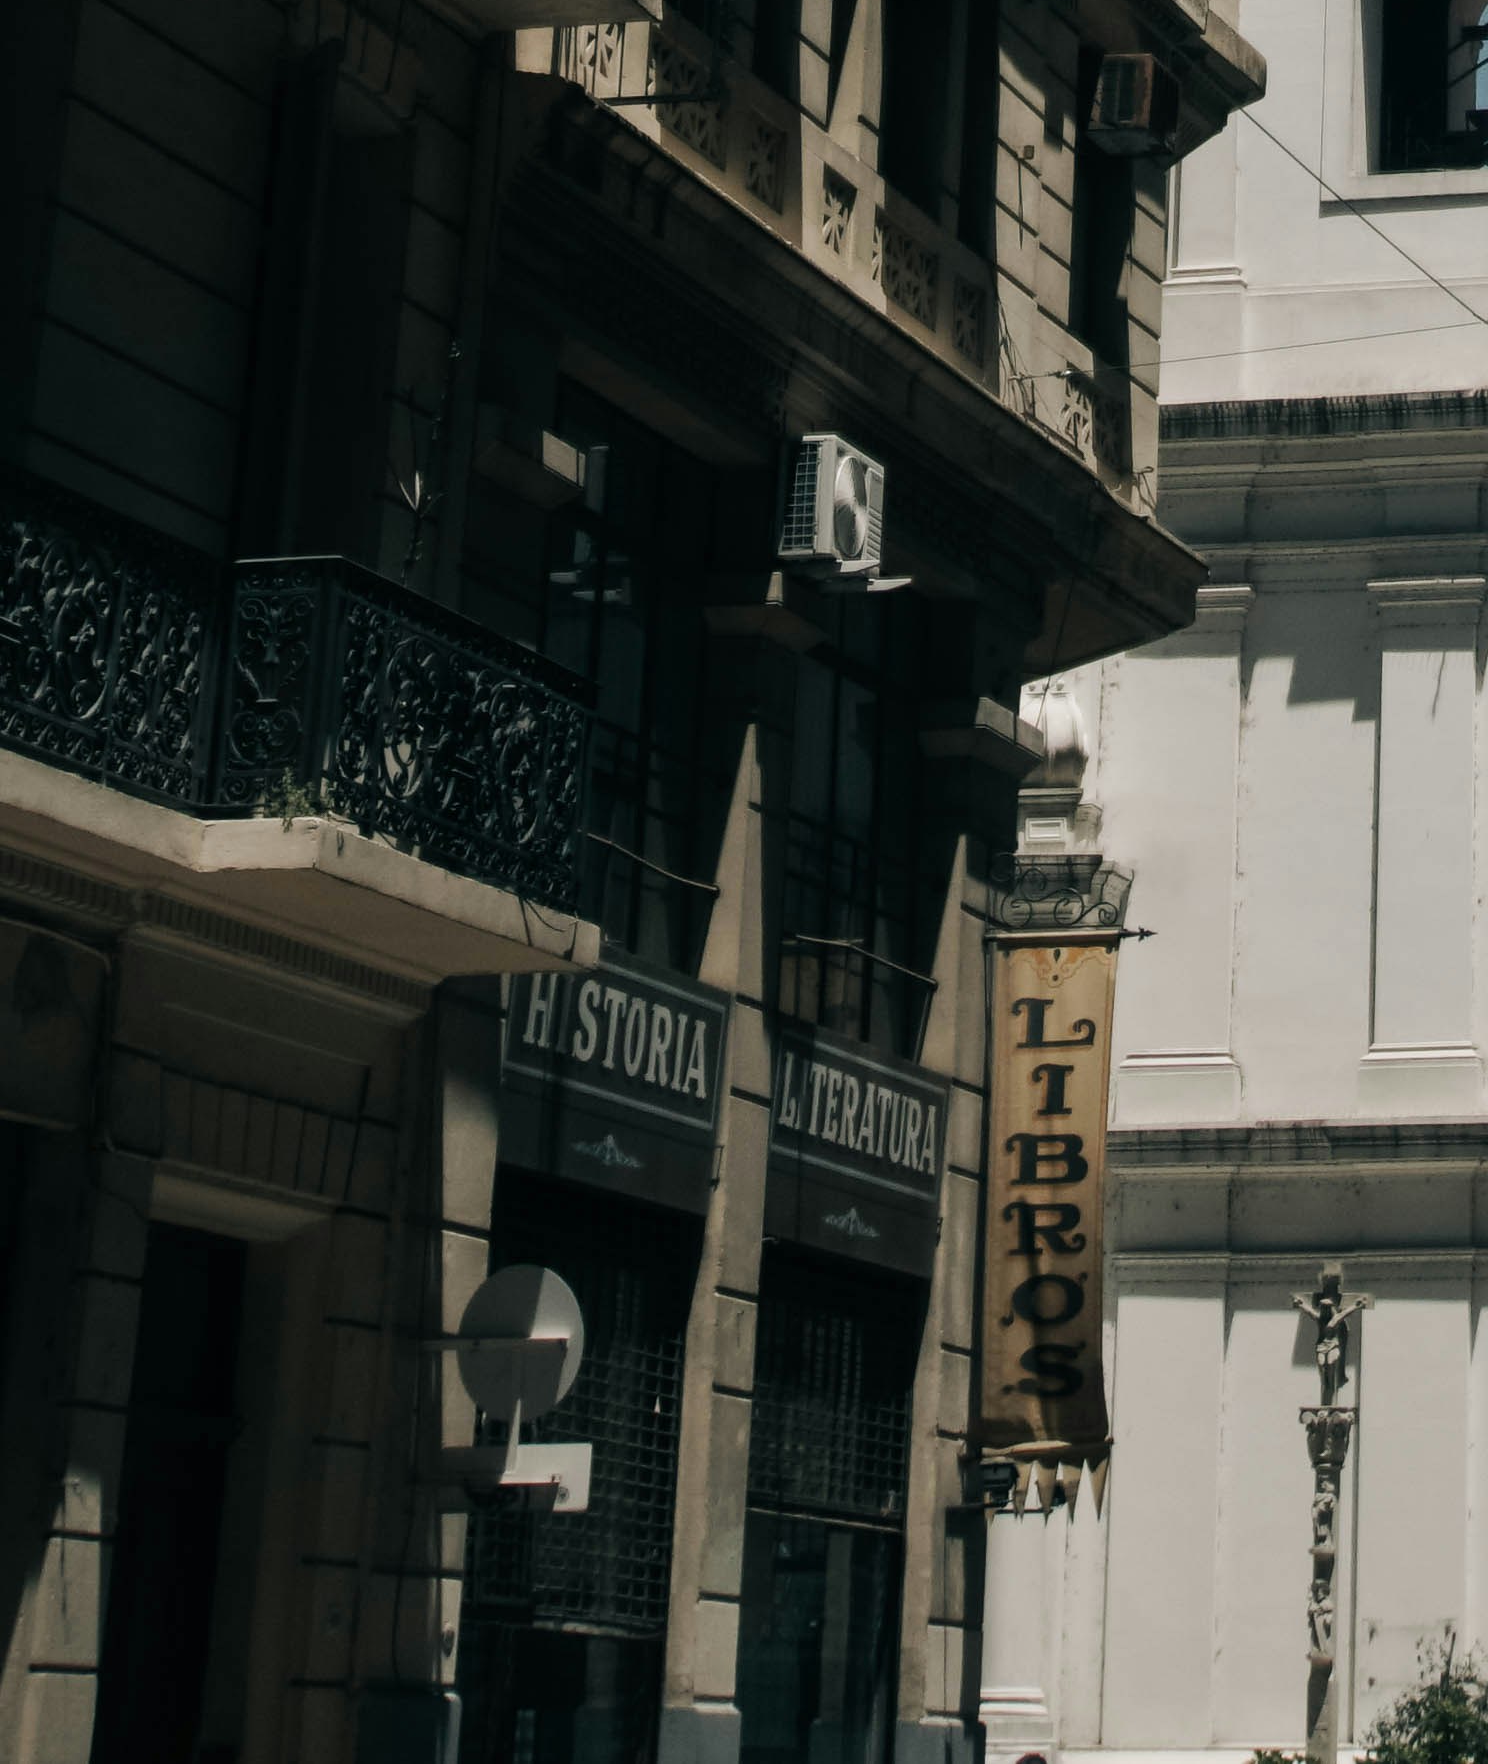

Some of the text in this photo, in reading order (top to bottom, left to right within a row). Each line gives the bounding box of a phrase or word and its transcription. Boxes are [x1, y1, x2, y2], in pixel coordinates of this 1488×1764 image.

[522, 973, 707, 1099] HISTORIA
[778, 1050, 937, 1176] LITERATURA
[1000, 997, 1097, 1397] LIBROS
